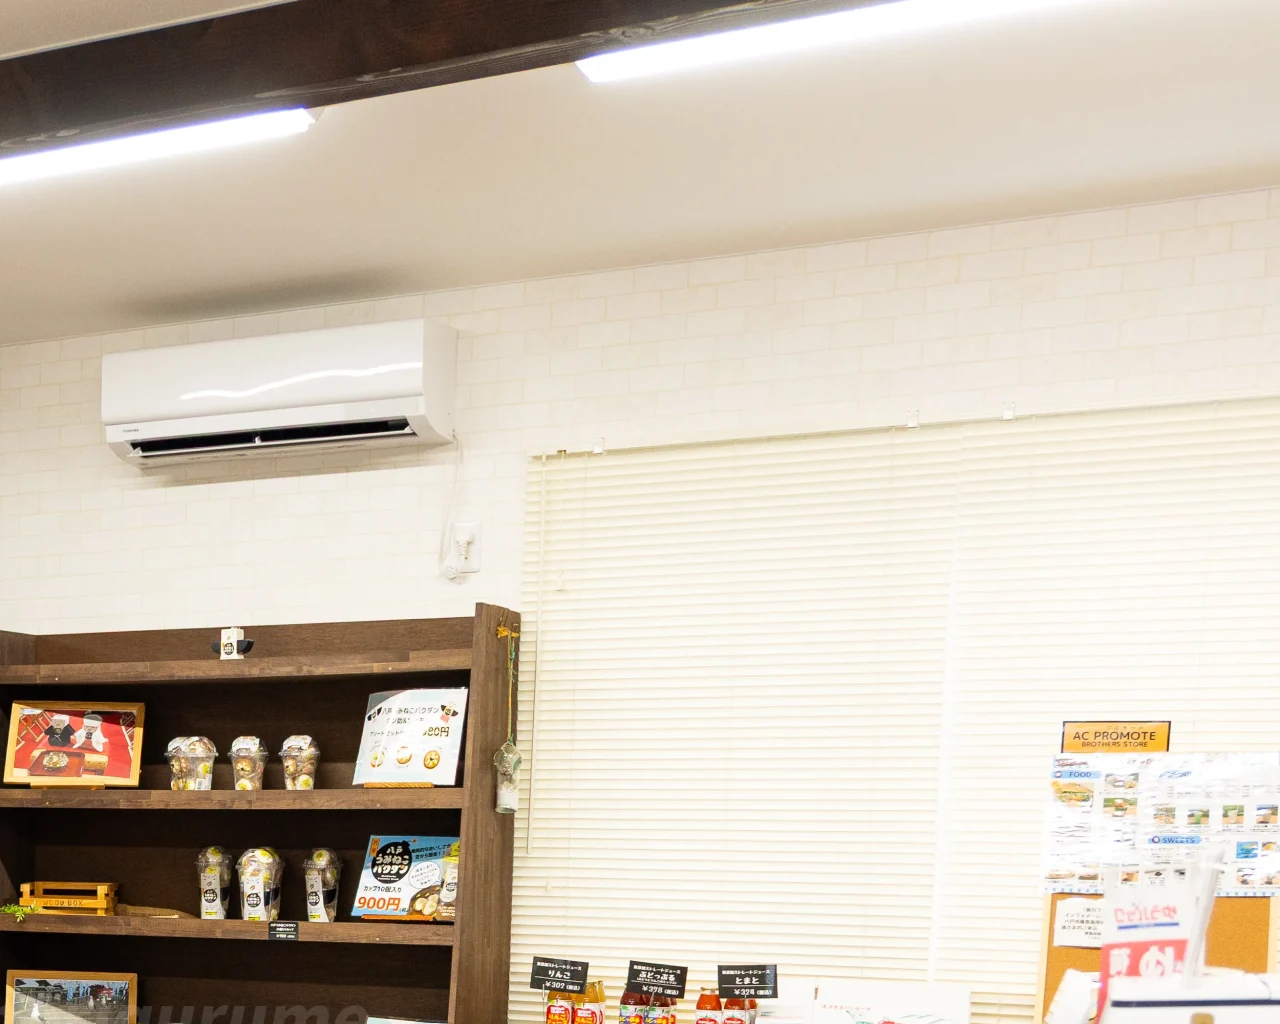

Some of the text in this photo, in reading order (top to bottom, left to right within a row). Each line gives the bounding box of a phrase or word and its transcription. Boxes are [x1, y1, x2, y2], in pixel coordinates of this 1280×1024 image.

[382, 706, 439, 715] 八戸みねこバクダン
[1073, 731, 1157, 741] AC PROMOTE
[1162, 836, 1195, 844] SWEETS
[386, 845, 403, 855] 八戸
[375, 854, 410, 865] うみねこ
[372, 863, 409, 874] バクダン
[67, 899, 84, 907] BOX
[357, 896, 402, 912] 900円
[545, 981, 565, 989] ¥302
[735, 976, 760, 985] とまと
